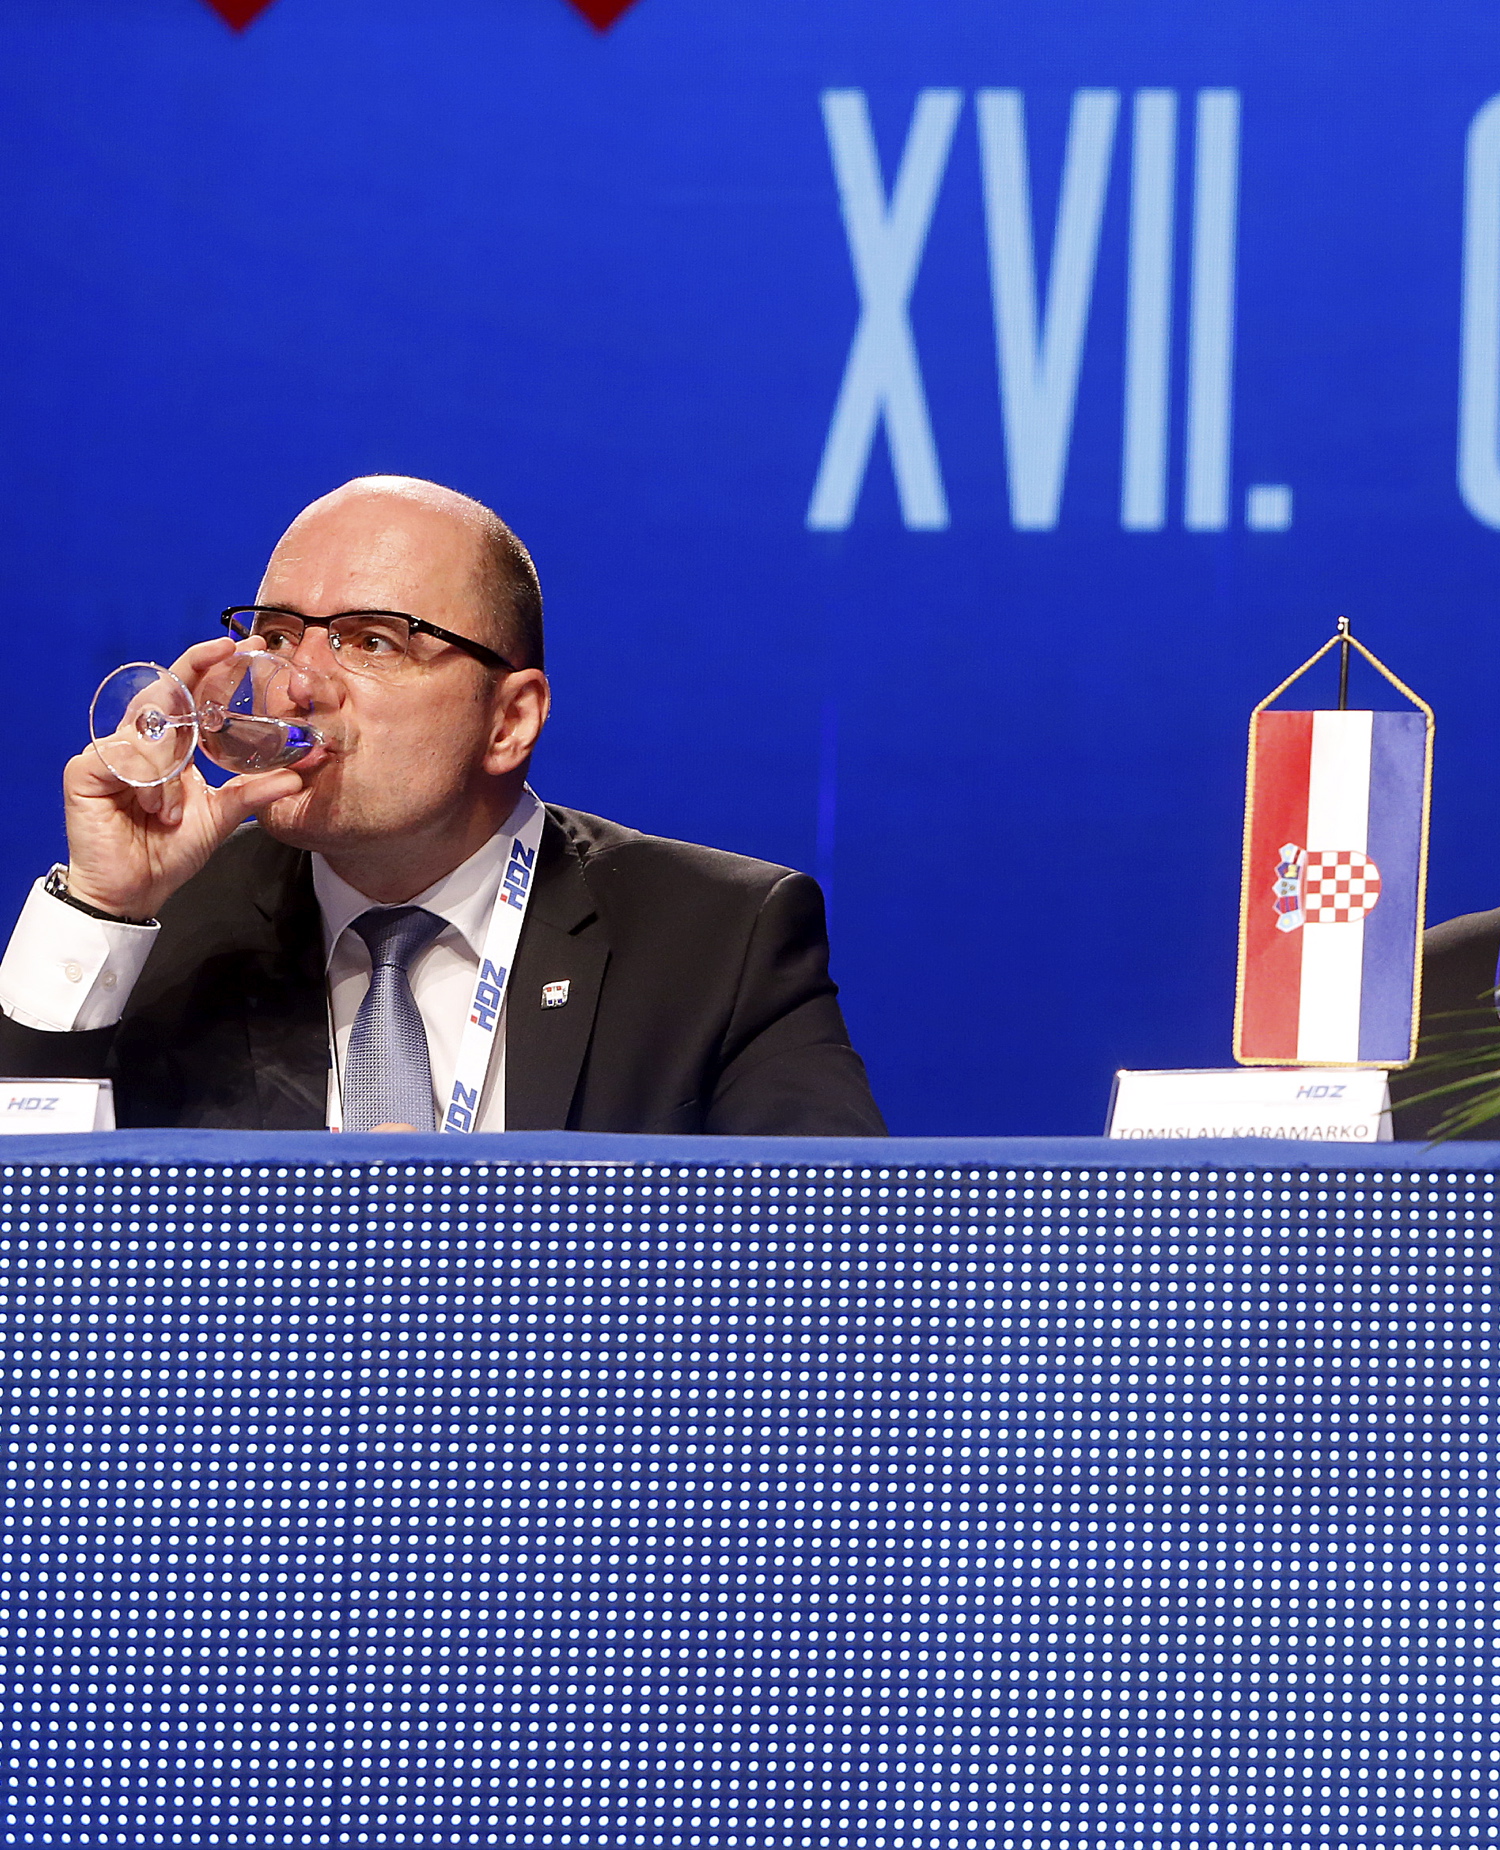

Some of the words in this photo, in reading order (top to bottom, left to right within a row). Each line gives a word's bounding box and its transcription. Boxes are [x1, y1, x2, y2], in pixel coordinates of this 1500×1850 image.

[807, 88, 1293, 530] XVII.
[500, 838, 536, 911] HDZ
[471, 958, 507, 1032] HDZ
[7, 1097, 59, 1110] HDZ
[1296, 1084, 1347, 1099] HDZ
[1117, 1126, 1225, 1139] TOMISLAV
[1231, 1124, 1369, 1140] KARAMARKO
